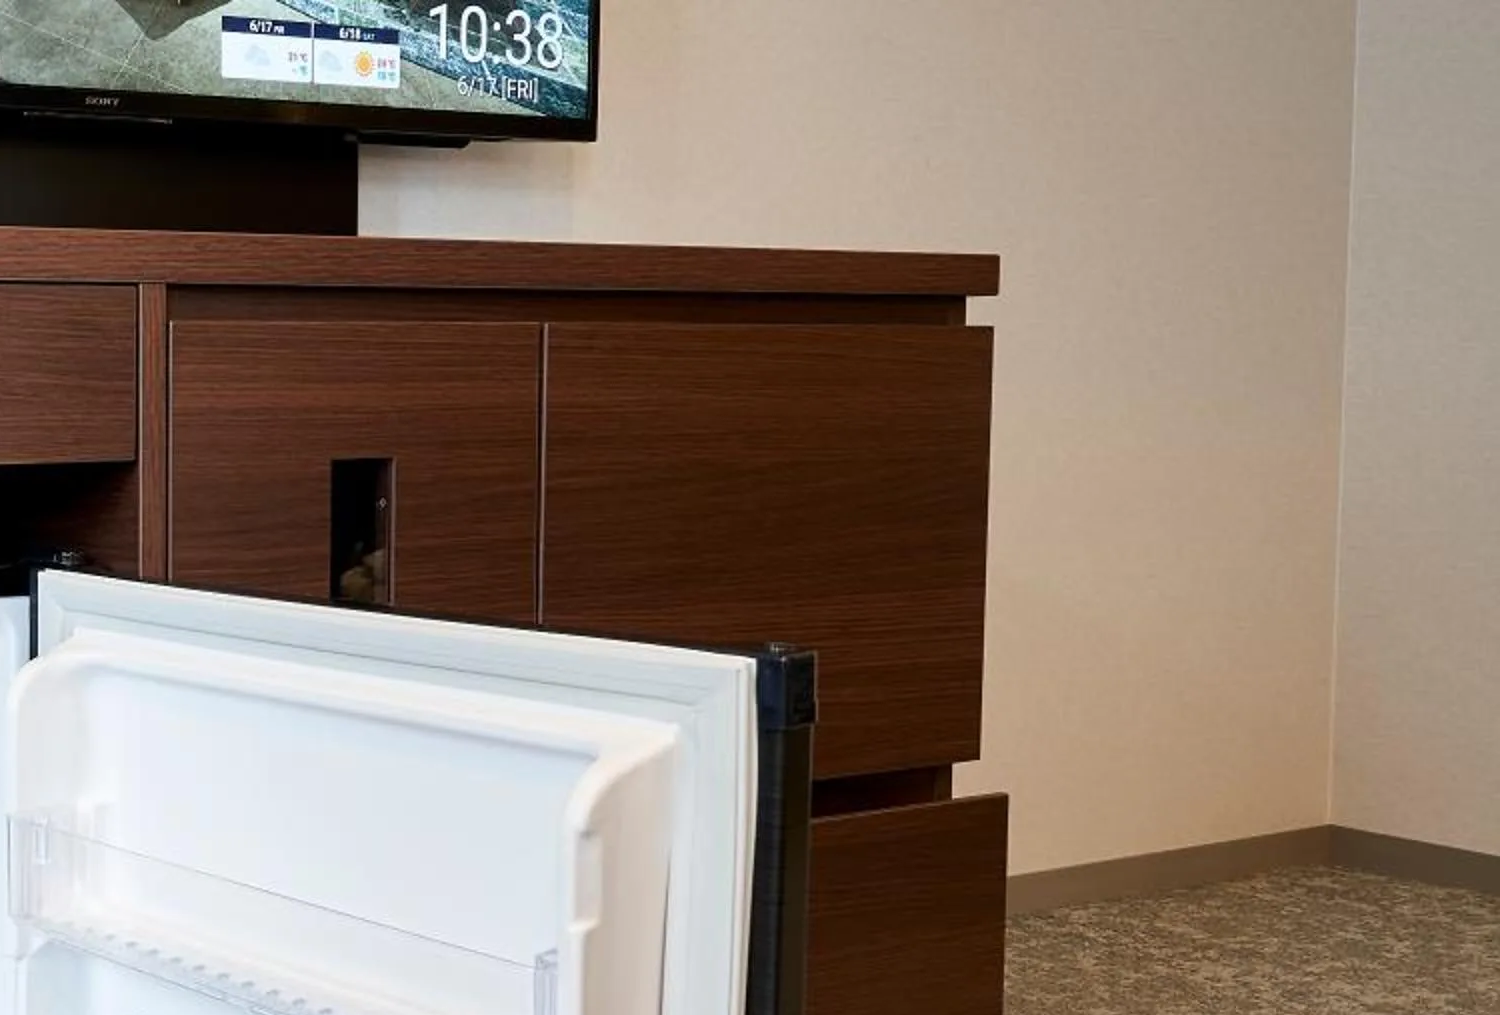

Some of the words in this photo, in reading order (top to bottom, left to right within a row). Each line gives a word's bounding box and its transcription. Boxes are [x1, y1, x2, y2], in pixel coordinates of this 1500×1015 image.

[249, 21, 273, 34] 6/17
[429, 3, 563, 69] 10:38
[457, 75, 499, 97] 6/17
